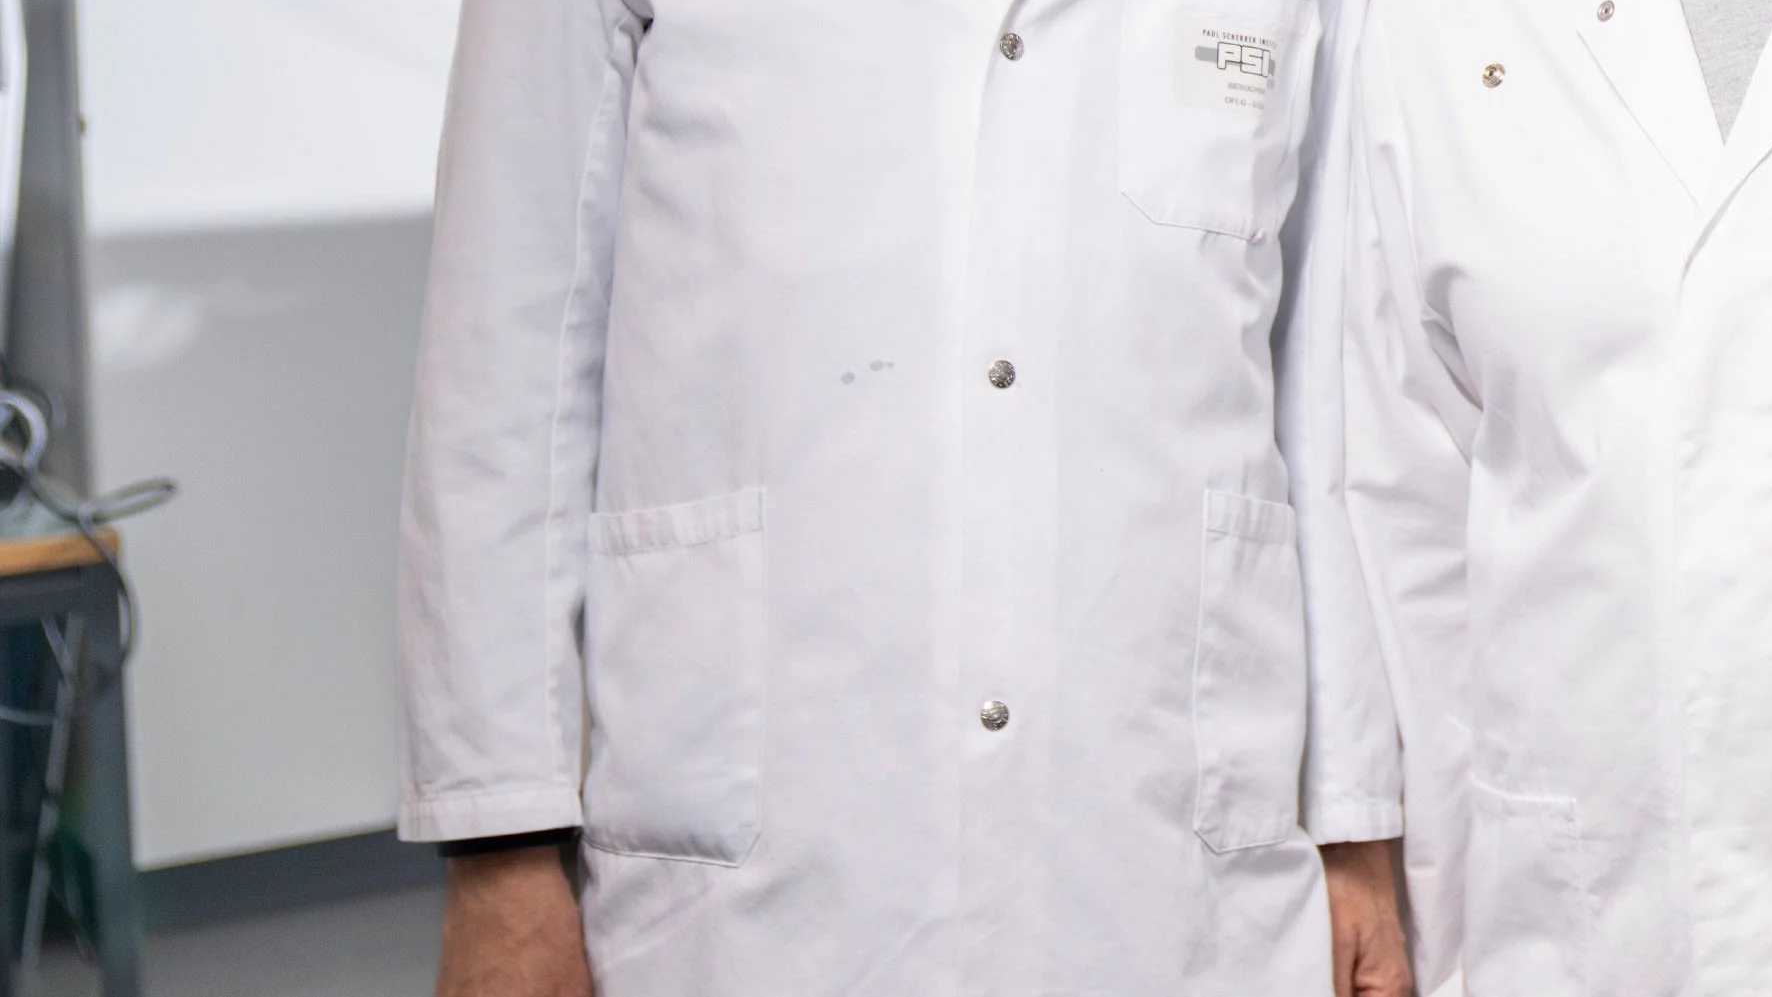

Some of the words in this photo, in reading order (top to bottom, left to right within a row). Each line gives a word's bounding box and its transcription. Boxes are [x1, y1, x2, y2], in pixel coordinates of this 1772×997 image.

[1202, 29, 1219, 39] PAUL
[1222, 32, 1257, 44] SCHERRER
[1217, 41, 1271, 79] PSI
